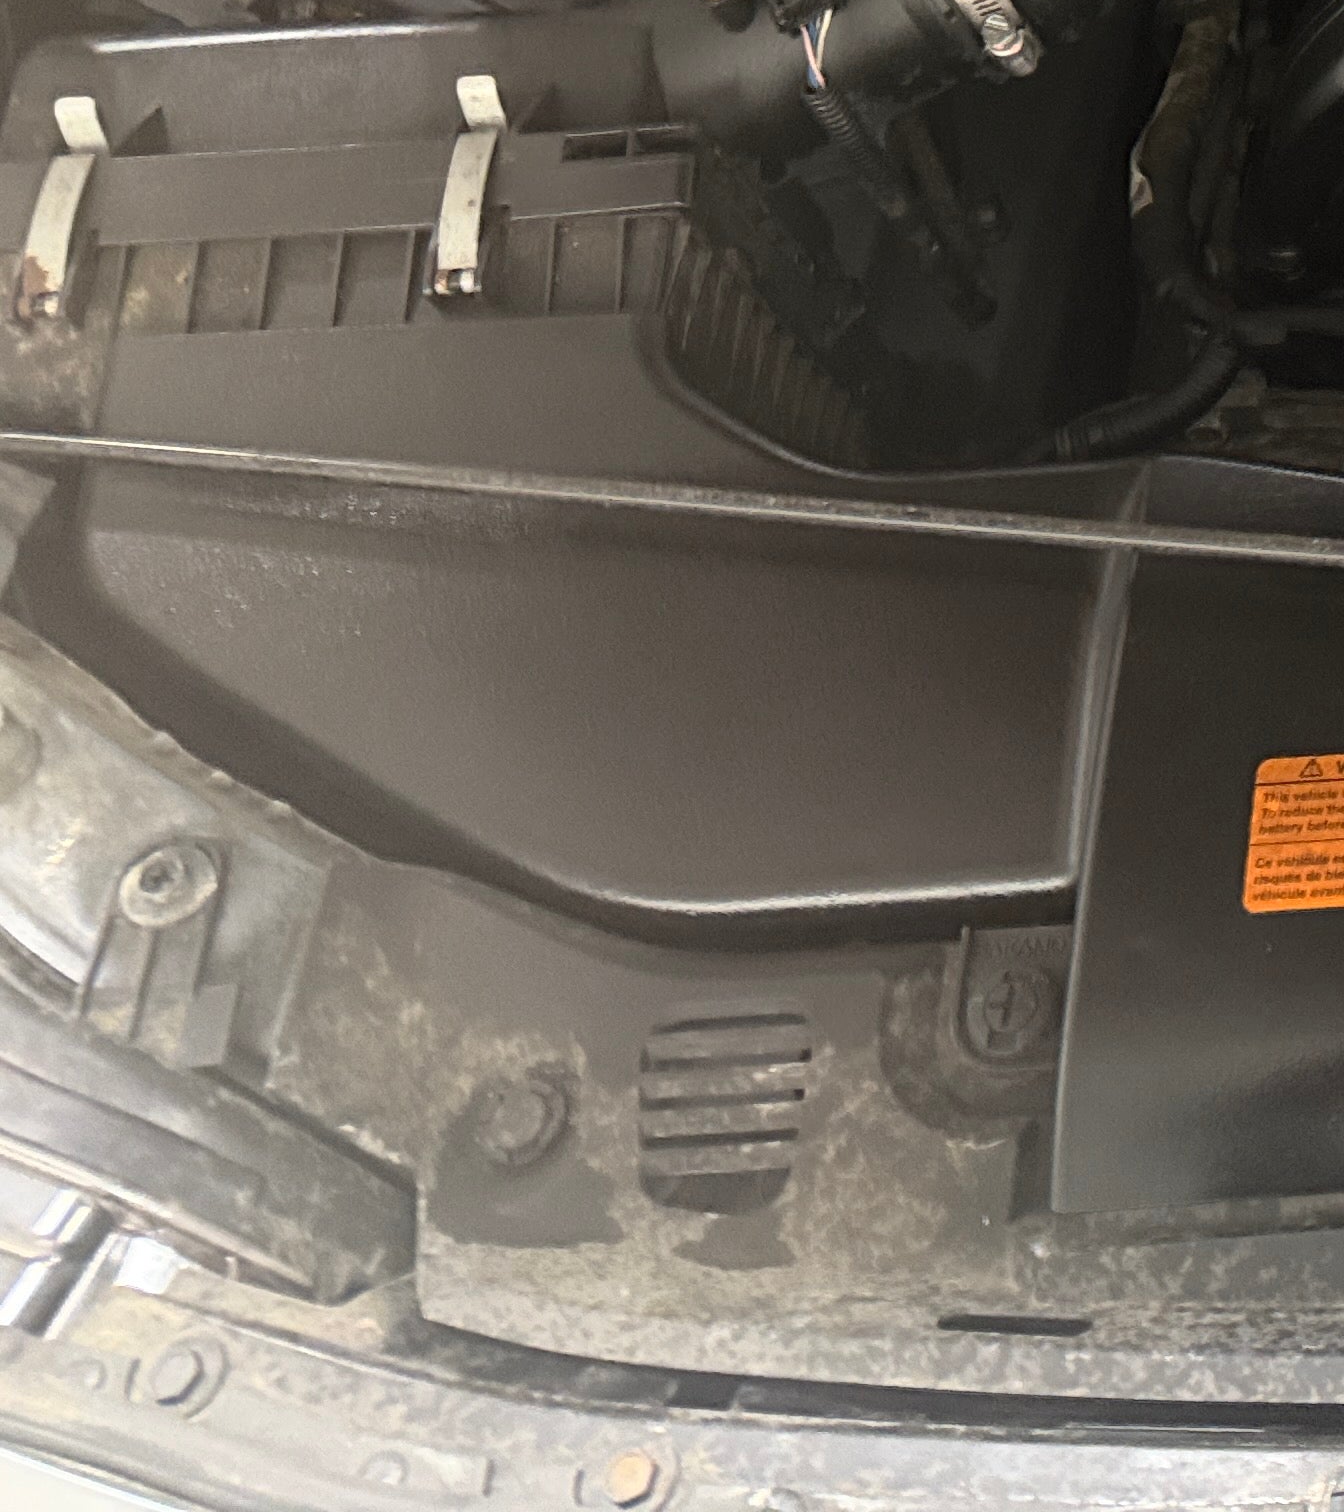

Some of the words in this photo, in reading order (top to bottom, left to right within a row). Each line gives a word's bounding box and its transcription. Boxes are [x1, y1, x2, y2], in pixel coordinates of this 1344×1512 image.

[1264, 790, 1289, 803] This
[1294, 786, 1338, 801] vehicle
[1262, 808, 1277, 819] To
[1281, 804, 1323, 817] reduce
[1259, 821, 1303, 837] battery
[1255, 857, 1272, 869] Ce
[1254, 871, 1301, 887] risques
[1306, 870, 1321, 881] de
